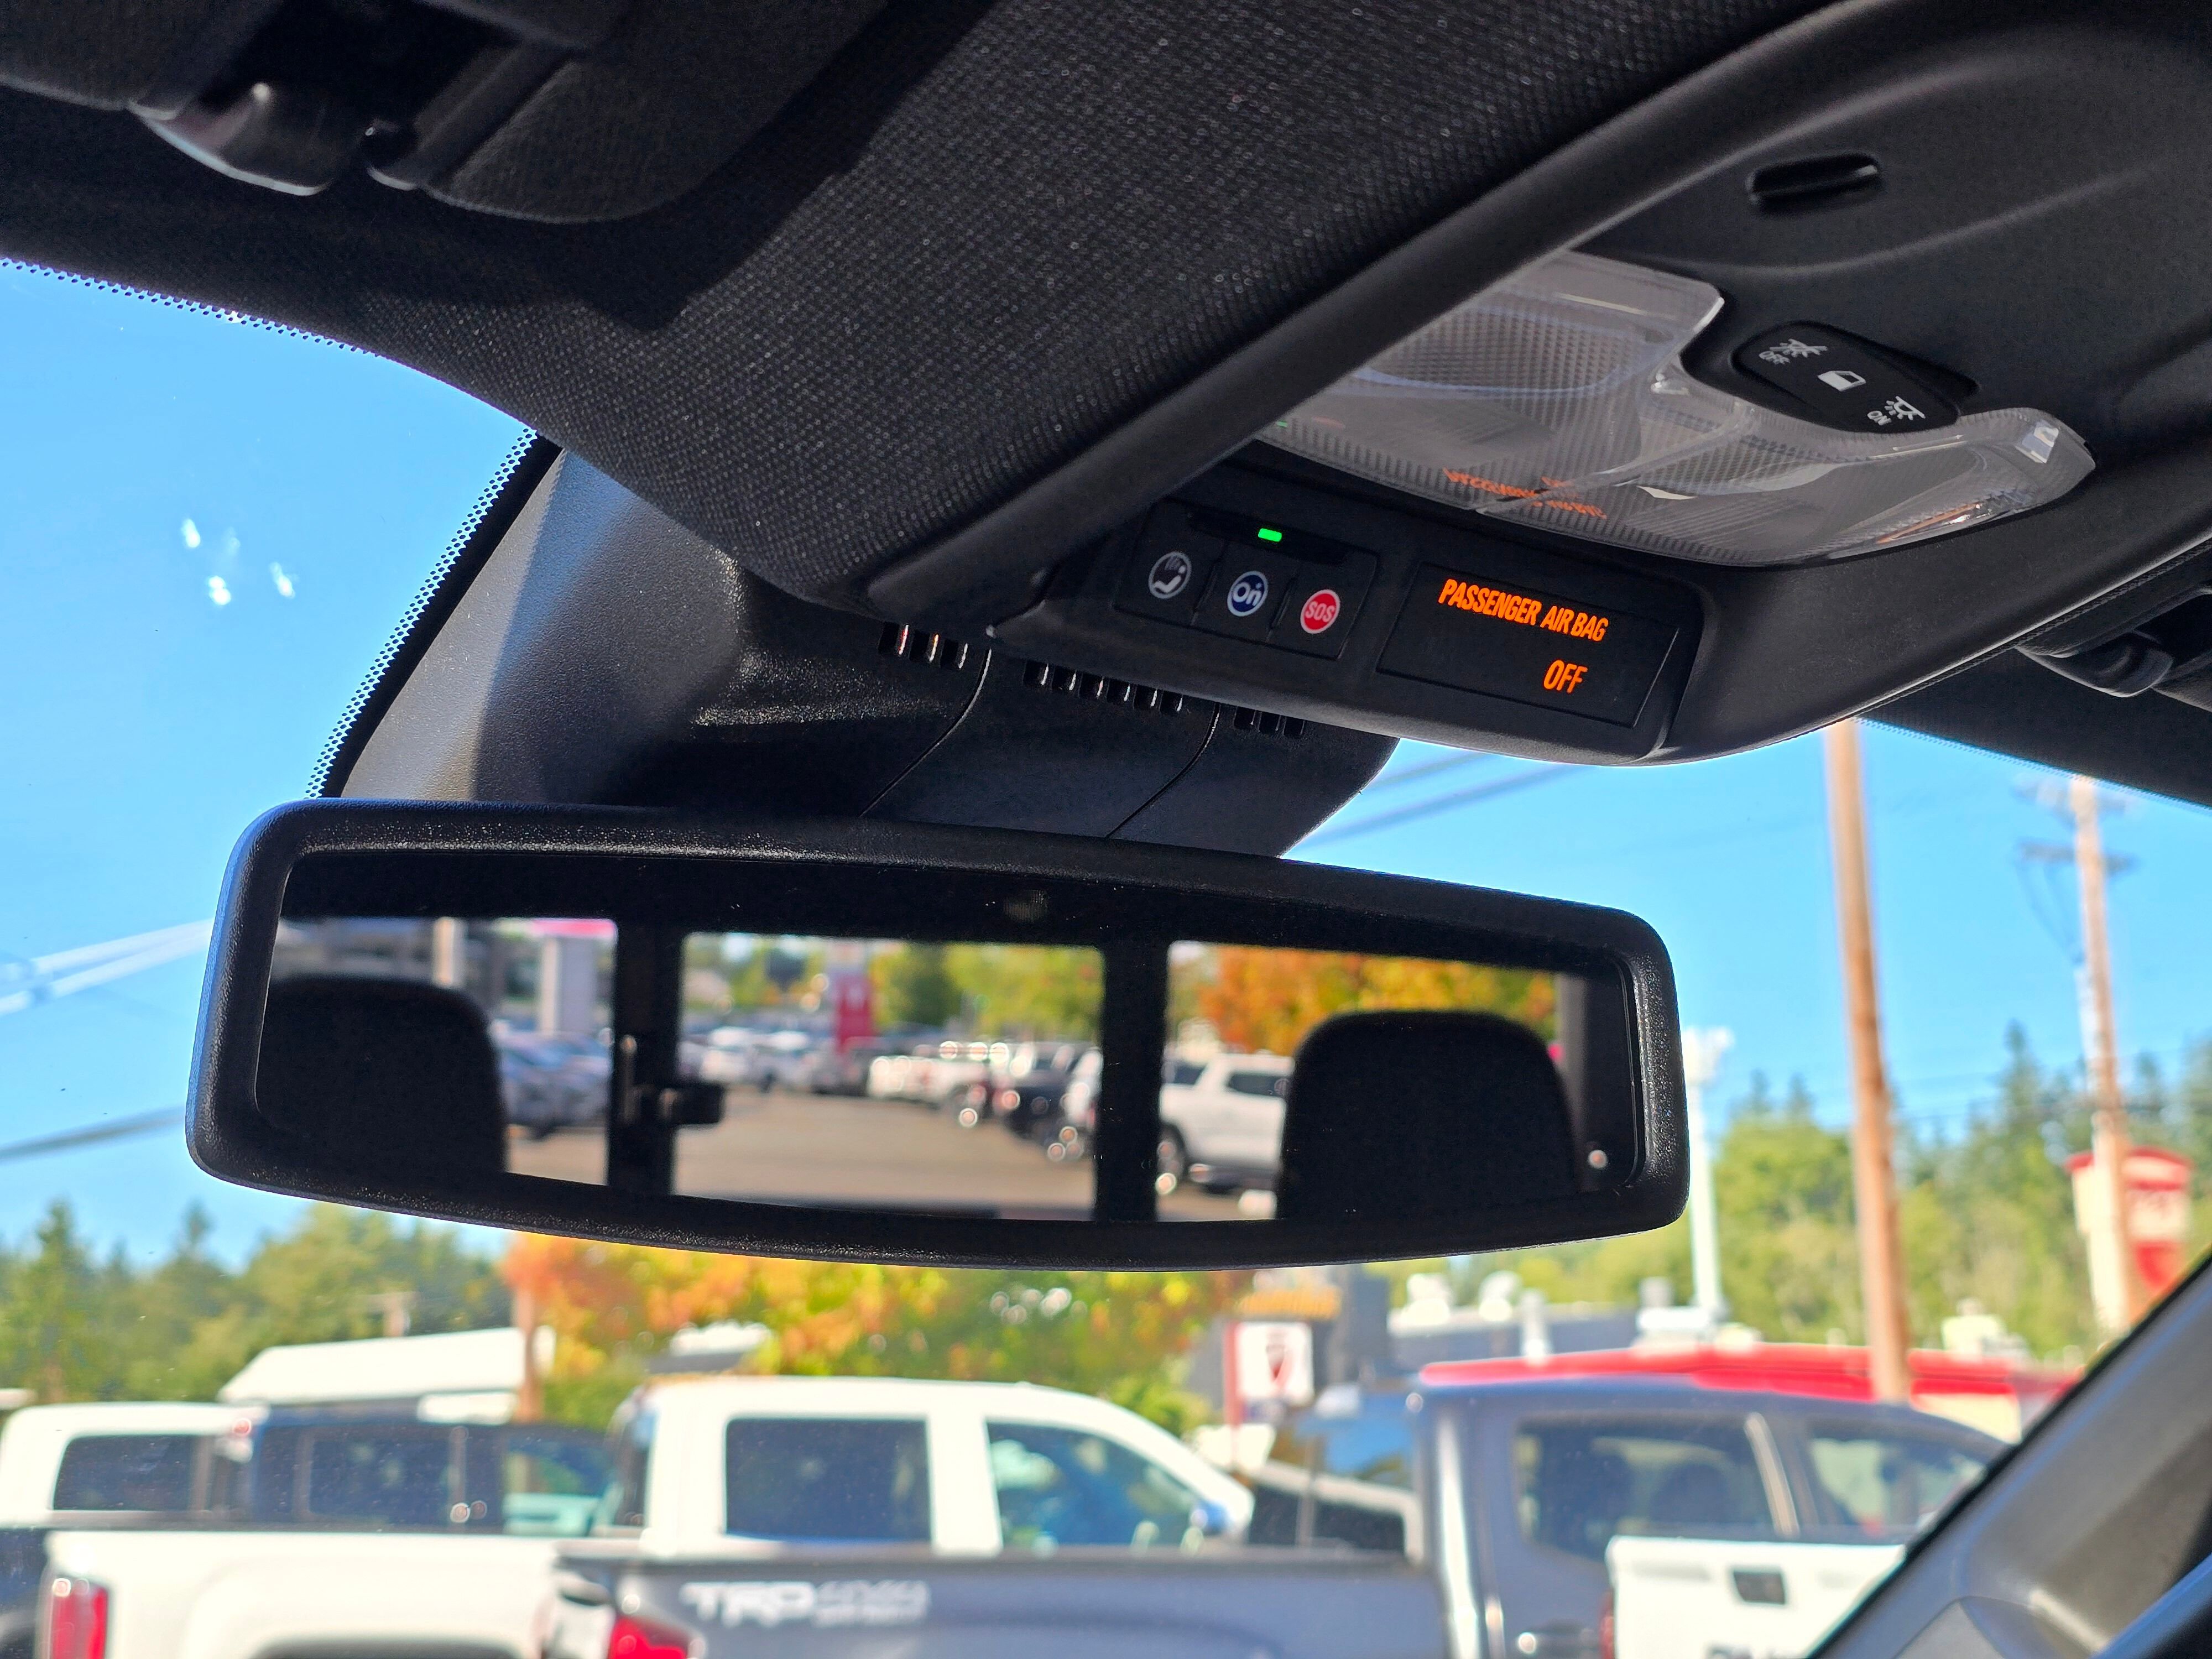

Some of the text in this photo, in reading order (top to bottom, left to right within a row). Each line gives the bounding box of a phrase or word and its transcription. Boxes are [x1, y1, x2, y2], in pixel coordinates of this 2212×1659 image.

[1867, 410, 1892, 425] ON
[1232, 582, 1262, 607] On
[1438, 578, 1542, 625] PASSENGER
[1305, 601, 1335, 623] SOS
[1543, 660, 1588, 693] OFF
